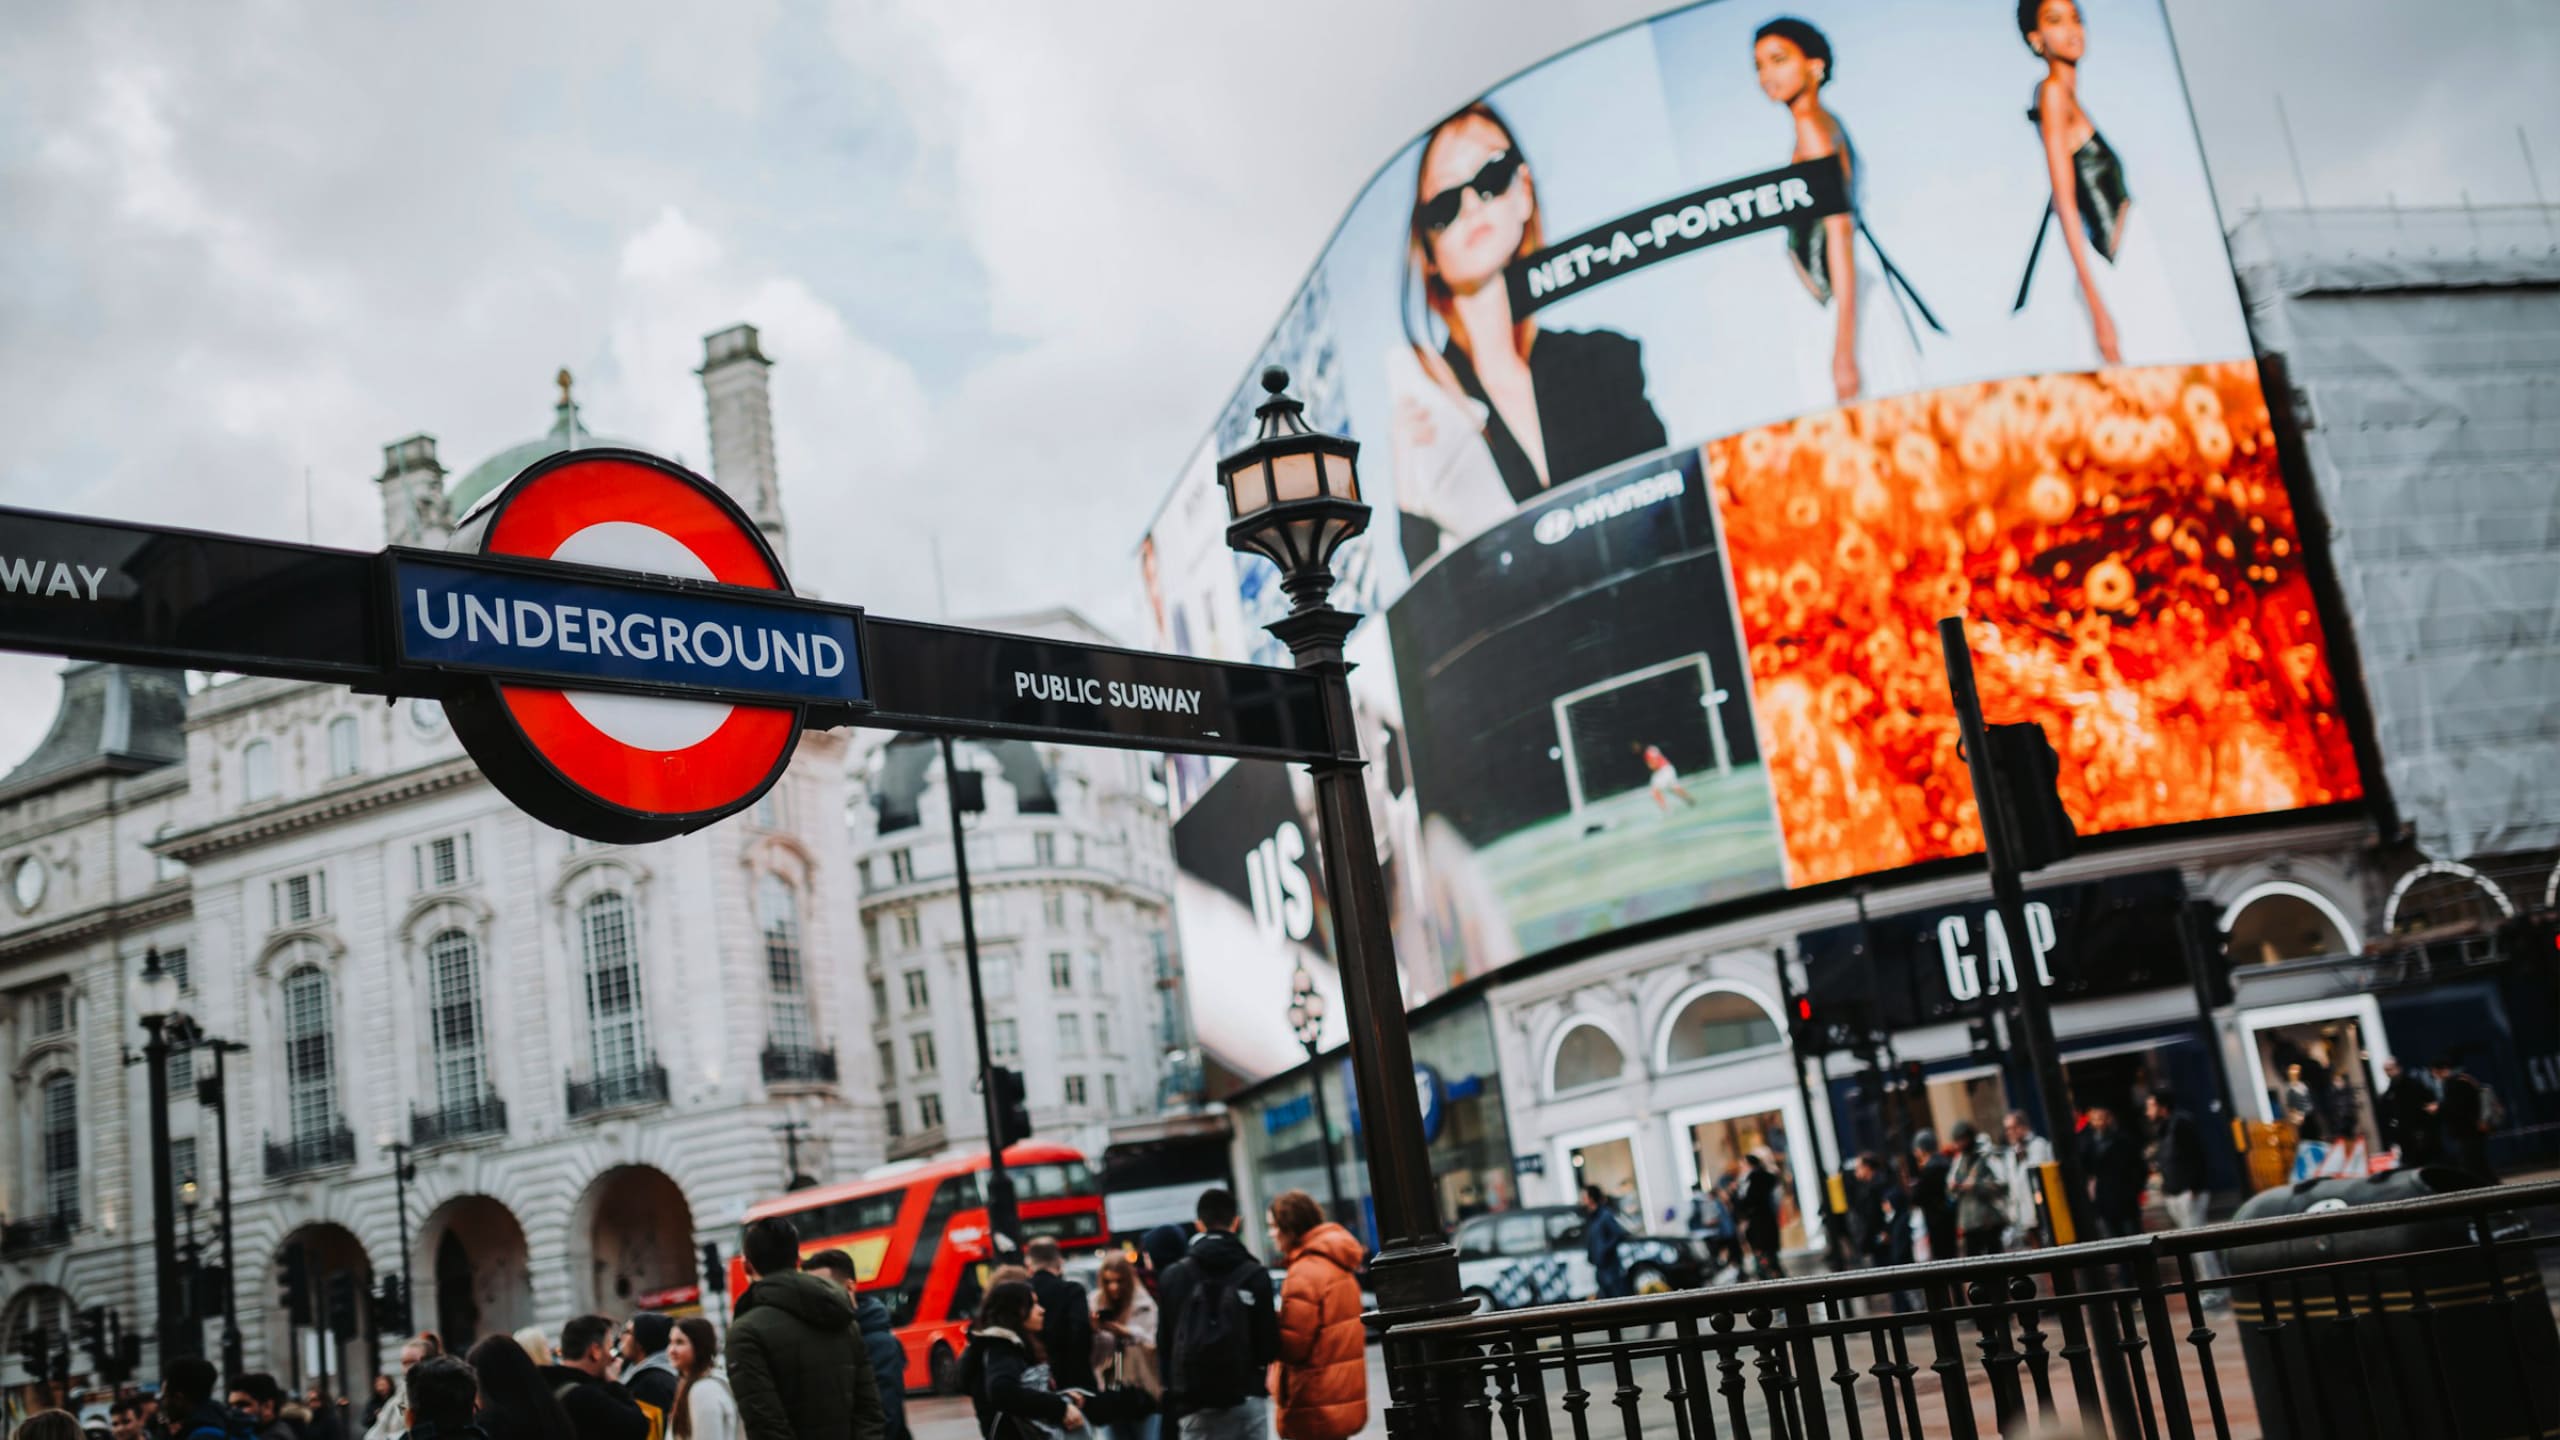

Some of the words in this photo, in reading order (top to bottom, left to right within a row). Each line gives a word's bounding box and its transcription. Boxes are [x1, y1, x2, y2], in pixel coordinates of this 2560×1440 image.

[1528, 178, 1814, 298] NET-A-PORTER
[0, 556, 107, 600] WAY
[416, 588, 845, 678] UNDERGROUND
[1014, 671, 1102, 706] PUBLIC
[1108, 681, 1201, 715] SUBWAY
[1937, 901, 2057, 1001] GAP
